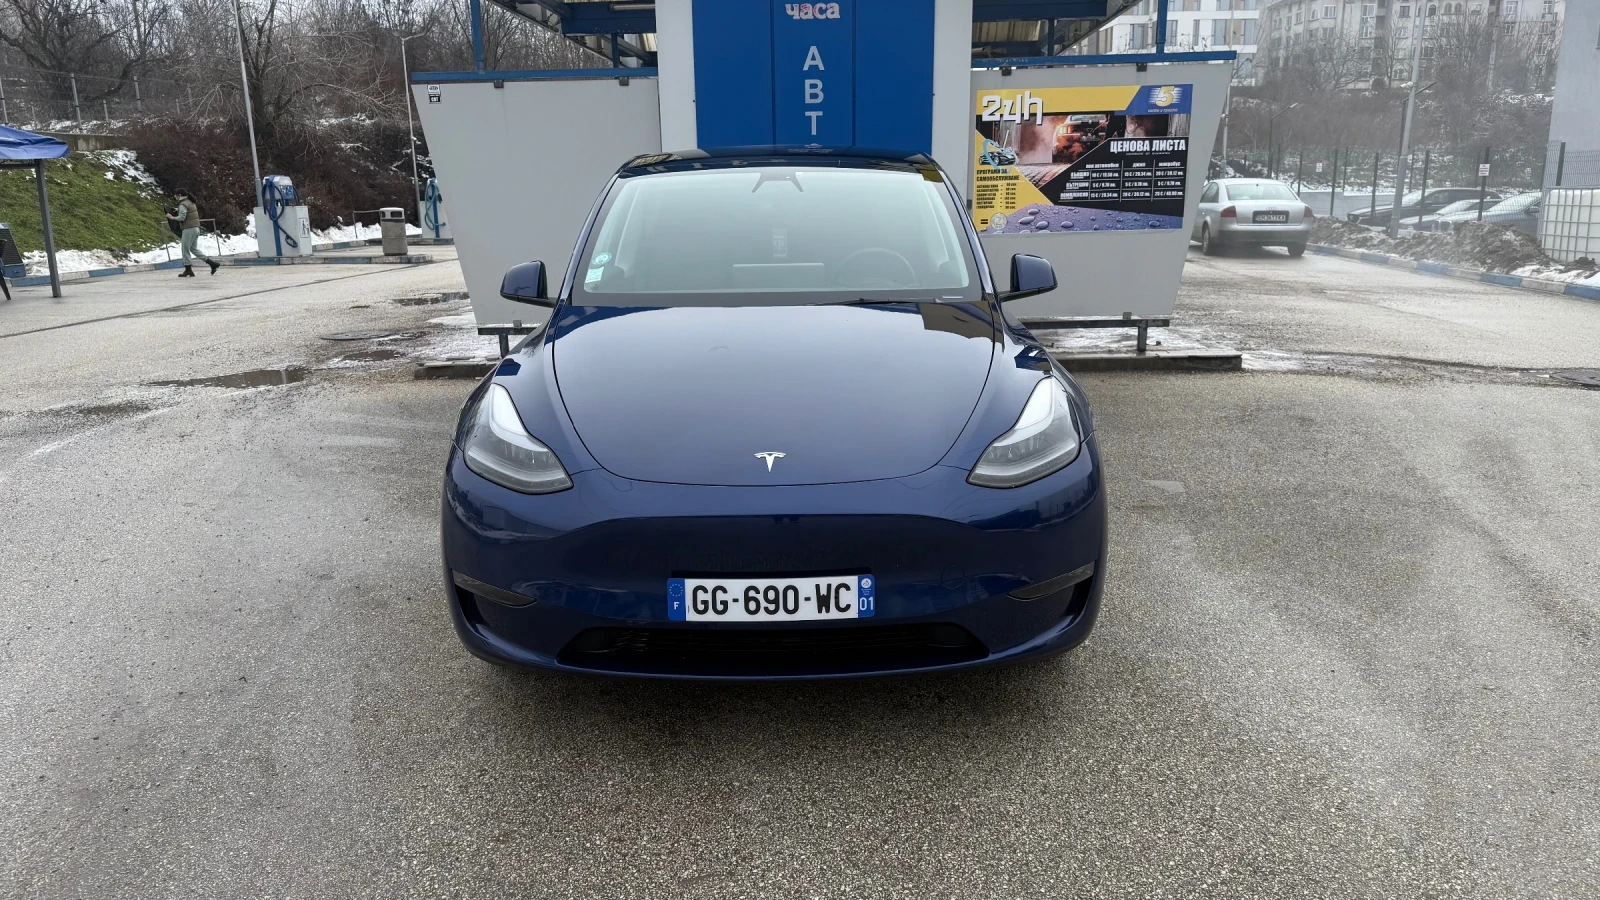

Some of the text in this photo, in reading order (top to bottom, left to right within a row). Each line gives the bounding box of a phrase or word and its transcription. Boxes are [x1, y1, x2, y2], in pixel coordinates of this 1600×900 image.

[785, 2, 840, 20] часа
[803, 45, 825, 146] АВТ
[1155, 86, 1175, 107] 5
[982, 91, 1043, 125] 24h
[1110, 139, 1186, 154] ЦЕНОВА ЛИСТА
[673, 601, 680, 610] F
[692, 583, 852, 616] GG-690-WC
[860, 596, 874, 611] 01
